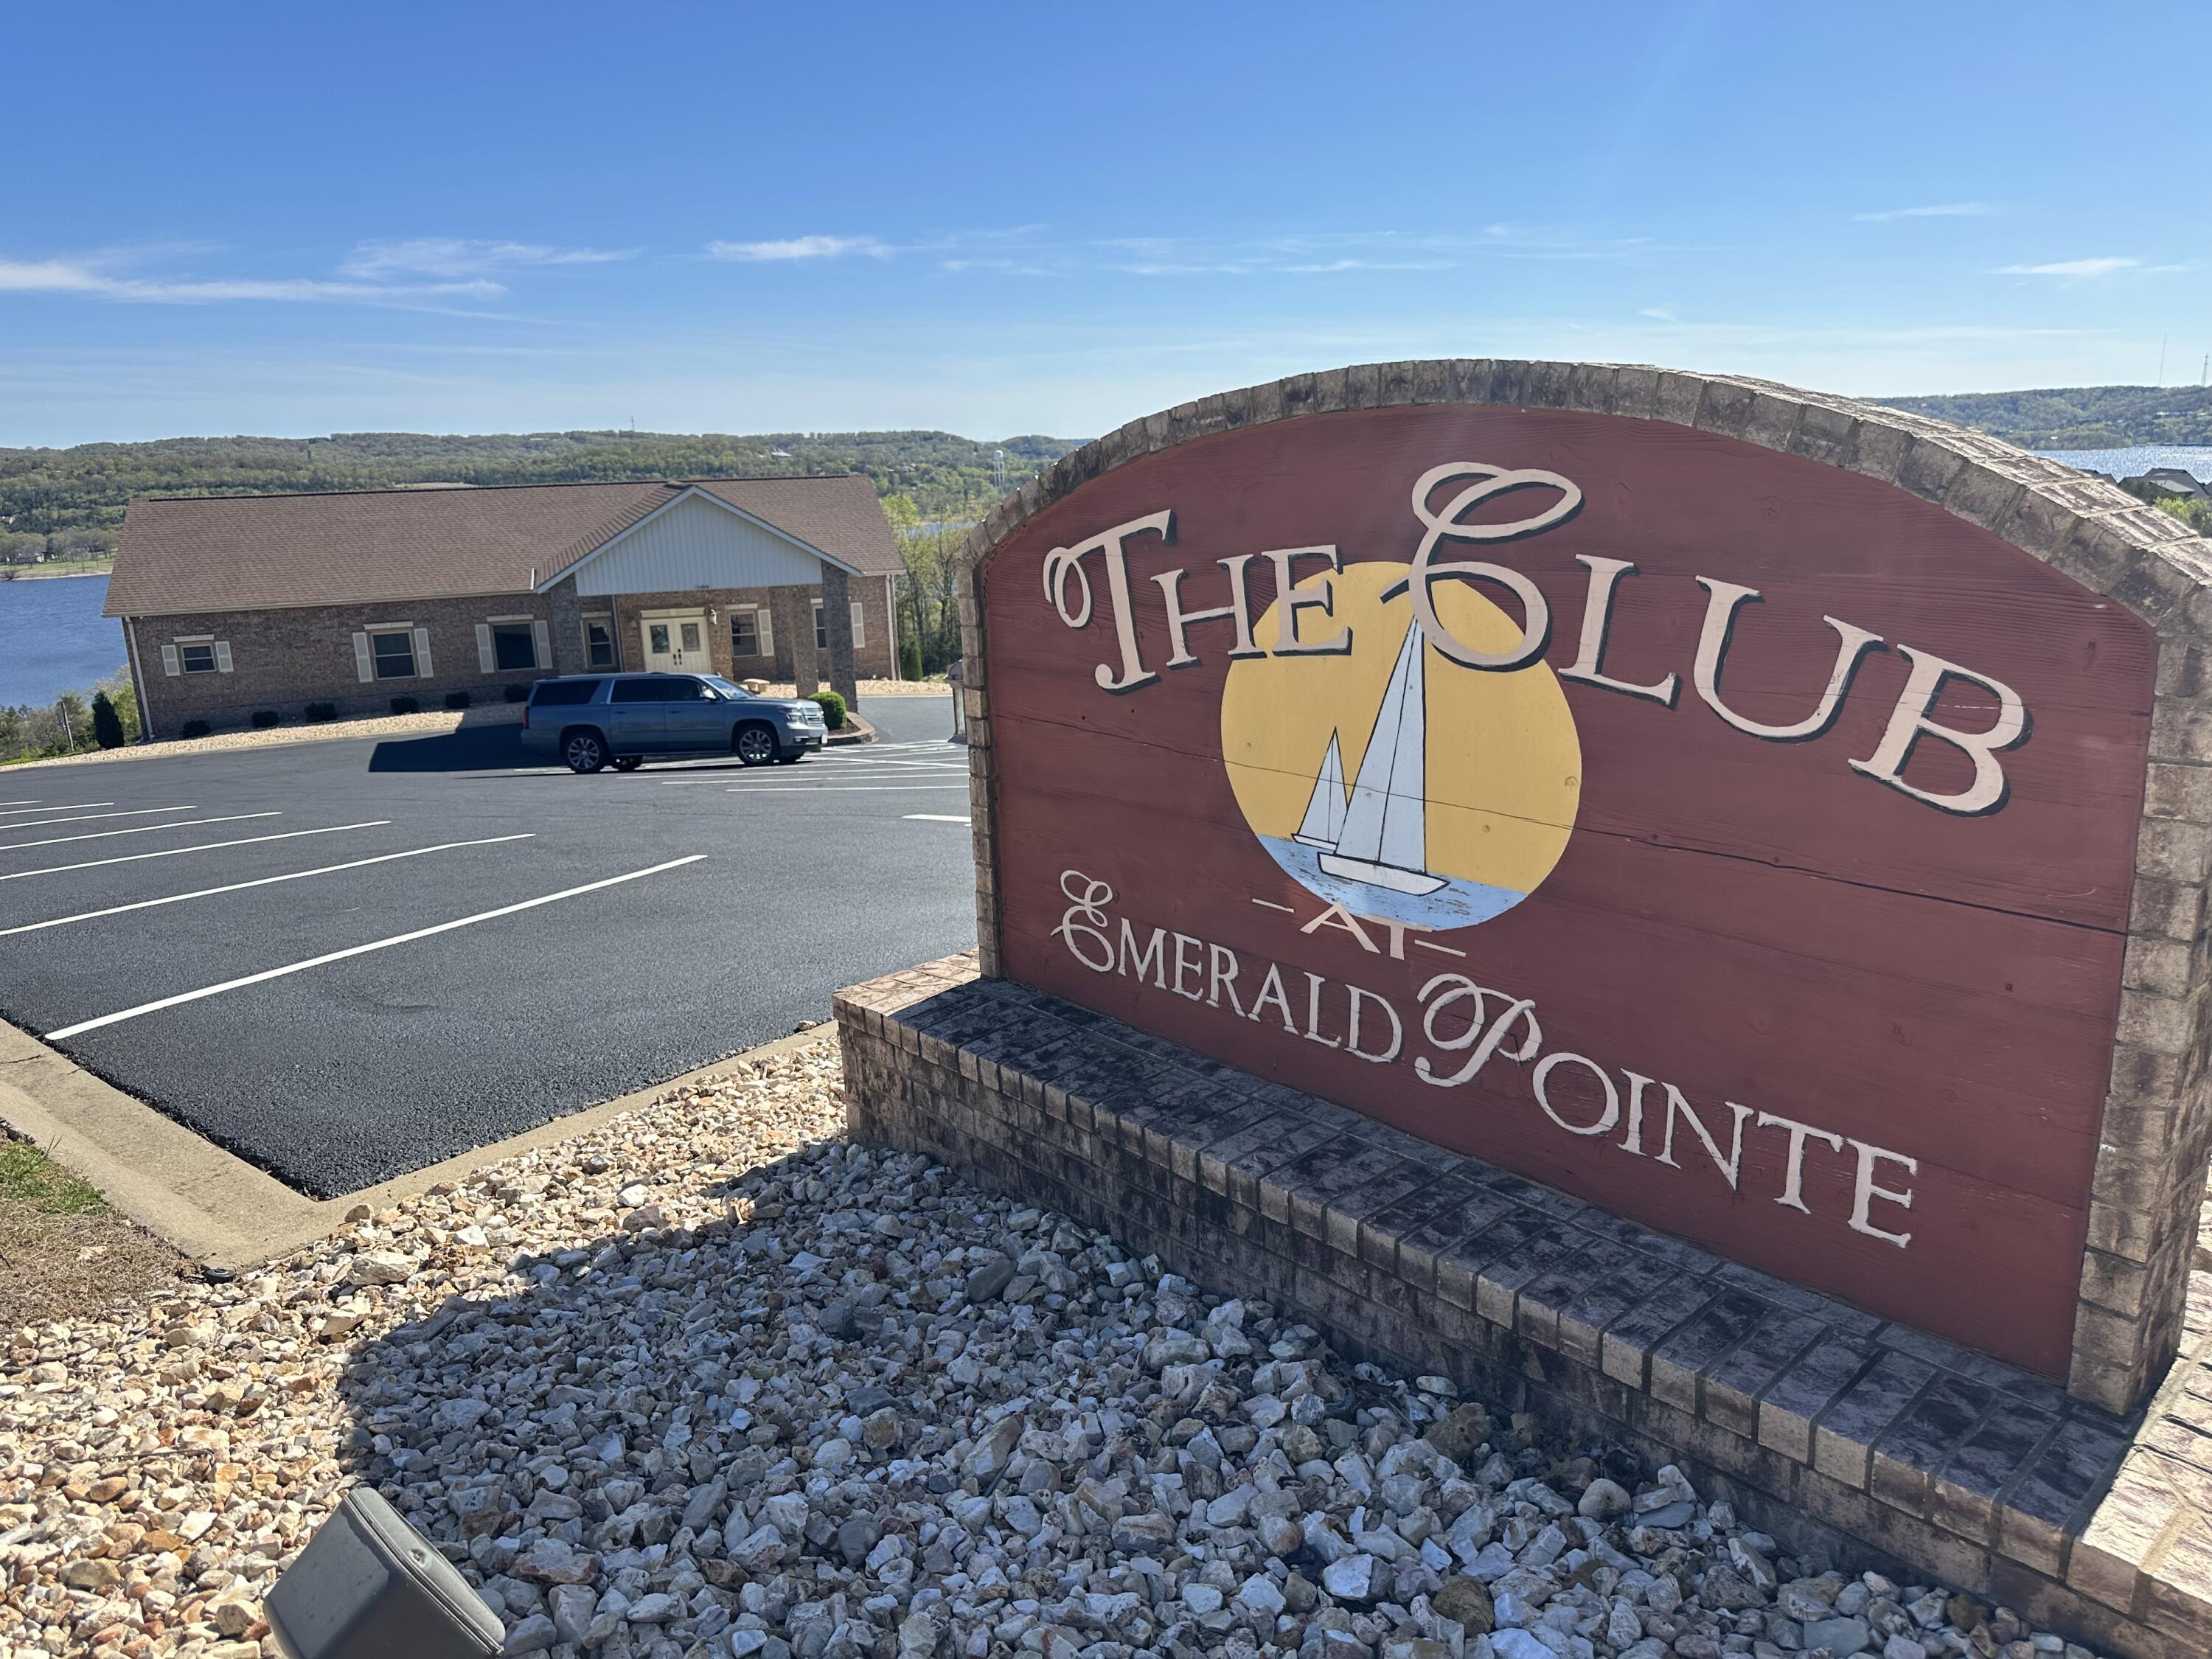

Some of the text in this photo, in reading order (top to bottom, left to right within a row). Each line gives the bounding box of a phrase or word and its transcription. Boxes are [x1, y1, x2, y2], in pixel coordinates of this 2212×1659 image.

[1043, 462, 2034, 816] THE CLUB
[1050, 869, 1919, 1249] EMERALD POINTE
[1299, 900, 1433, 961] AT
